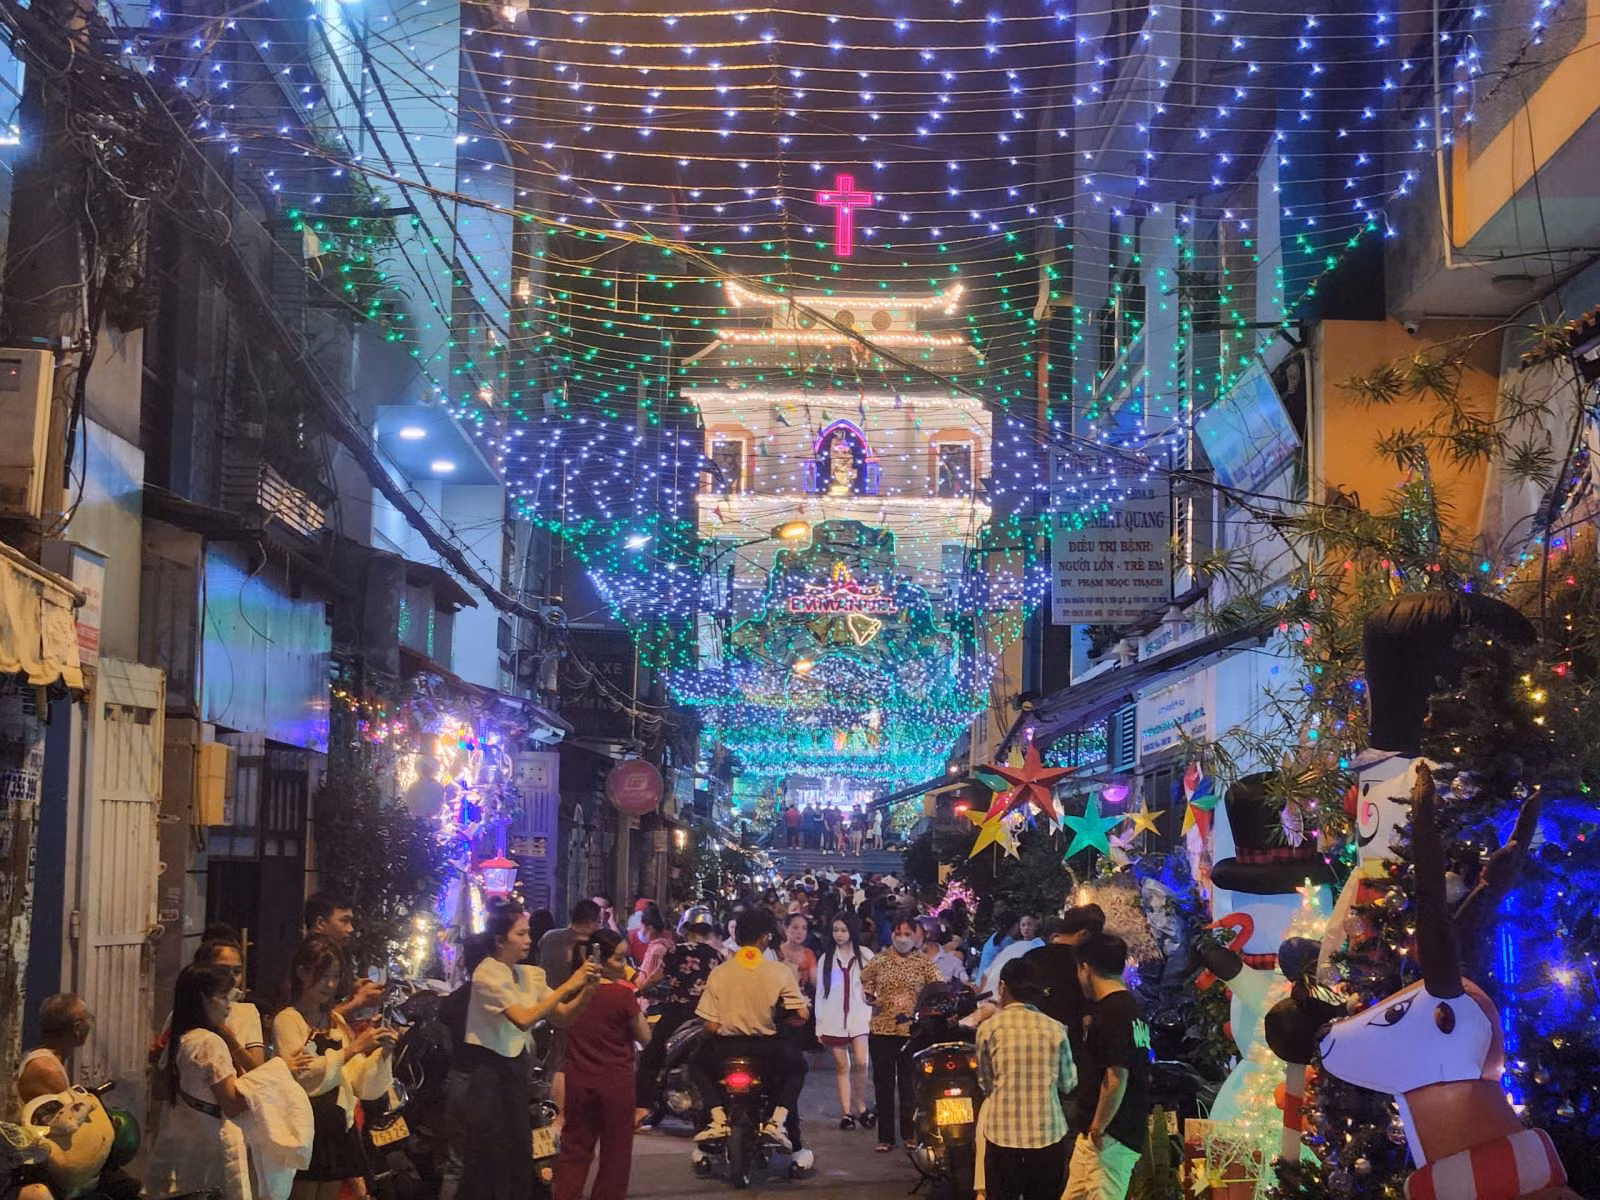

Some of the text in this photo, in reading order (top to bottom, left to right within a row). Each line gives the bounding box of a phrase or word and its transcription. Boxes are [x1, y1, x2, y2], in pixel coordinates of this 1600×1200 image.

[1125, 511, 1164, 532] QUANG
[1147, 560, 1165, 571] EM
[1077, 578, 1103, 589] PHẠM
[1105, 578, 1130, 589] NGỌC
[1132, 578, 1163, 589] THẠCH
[790, 596, 898, 612] EMMANUEL
